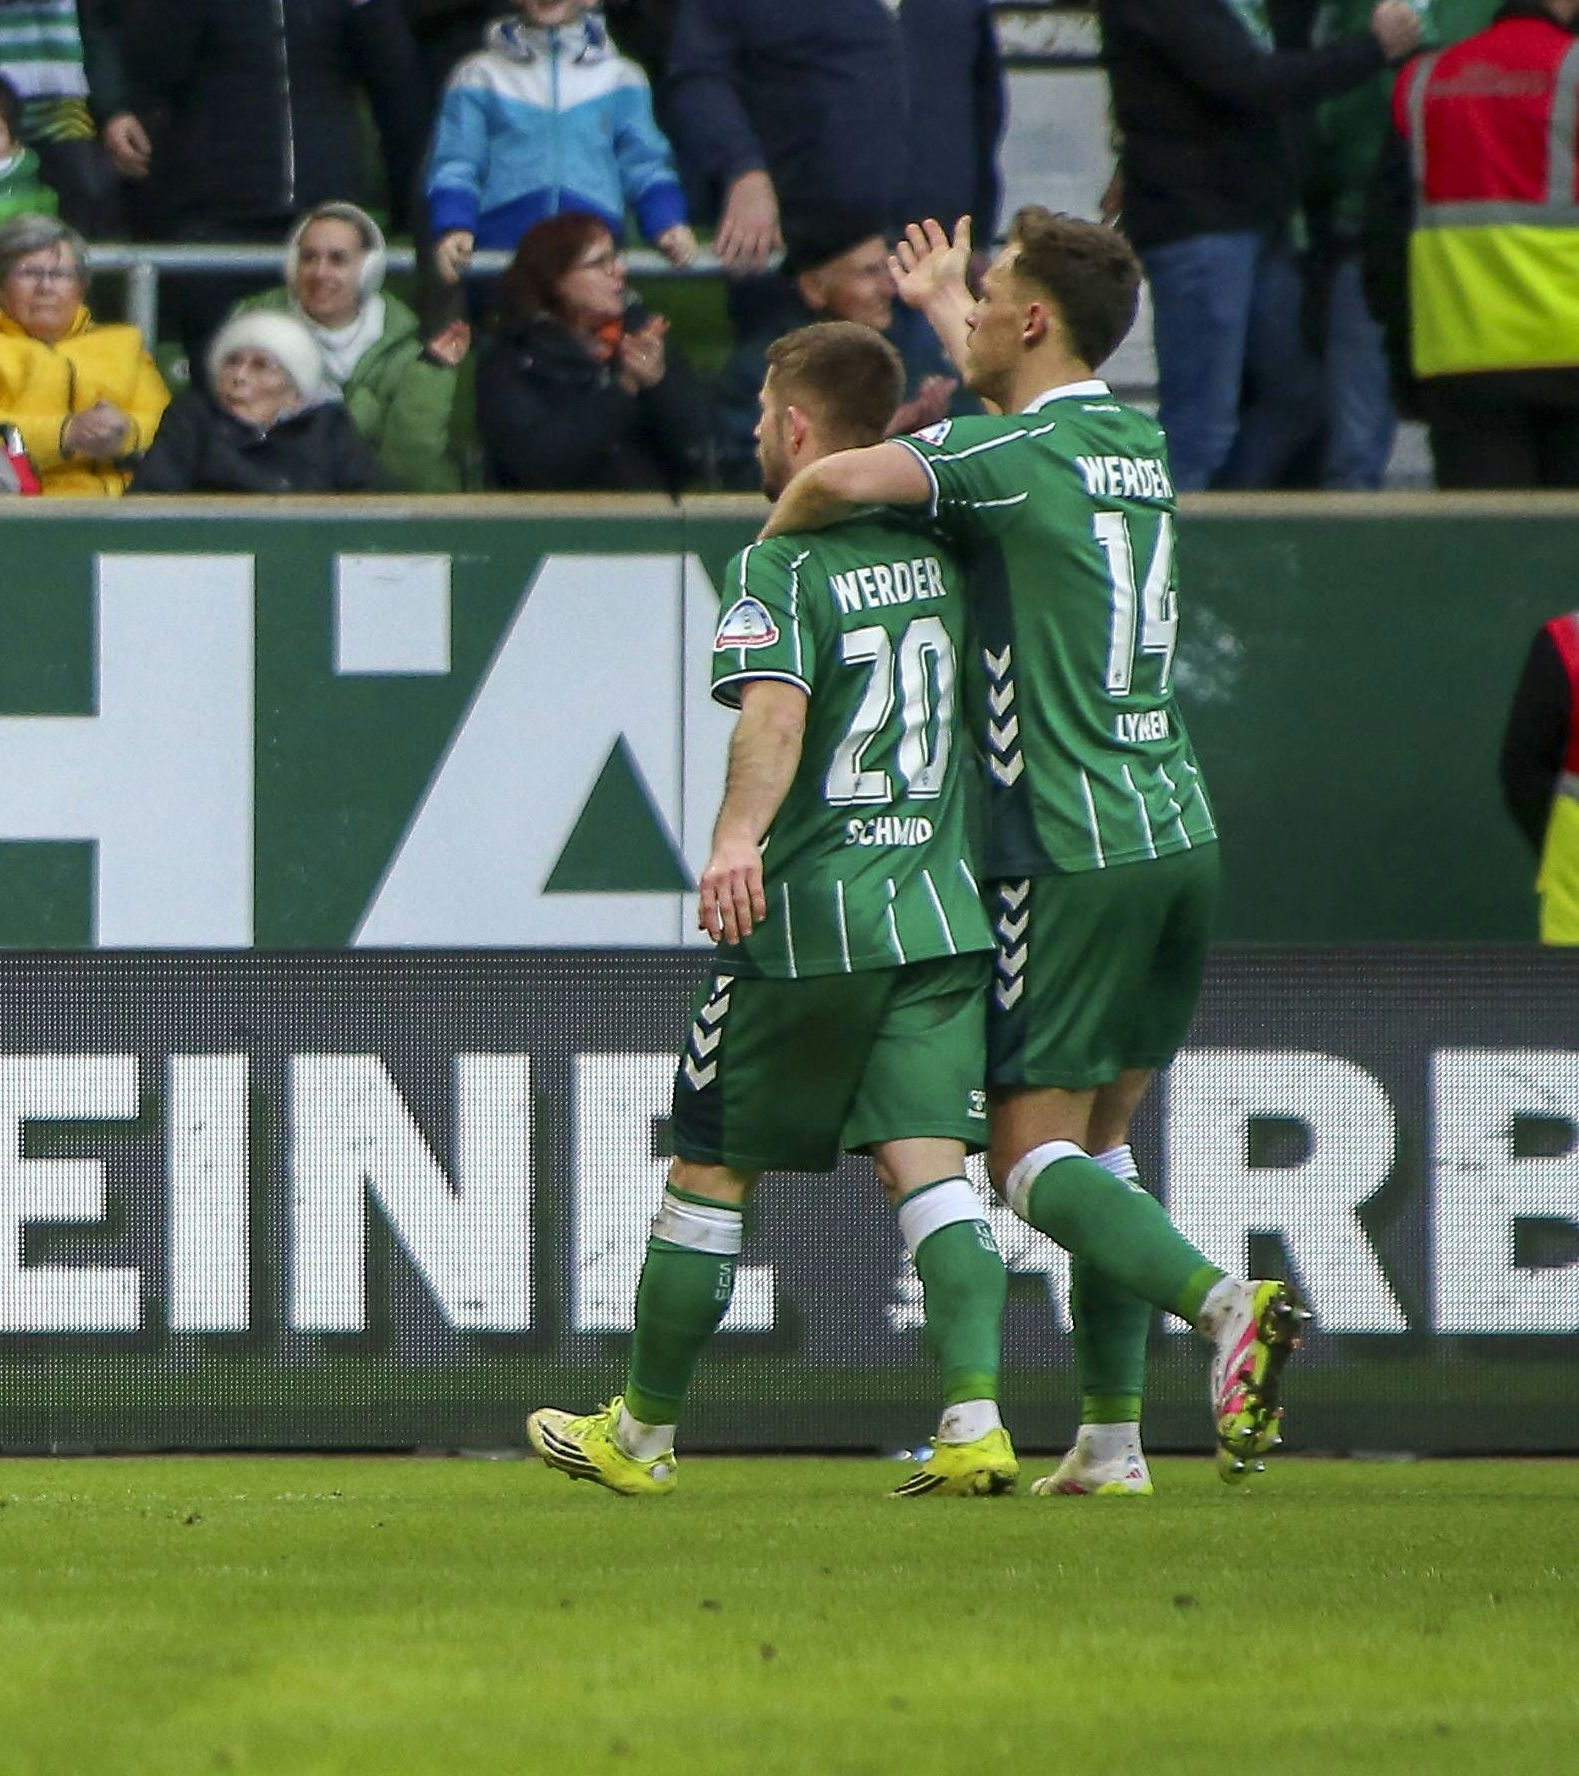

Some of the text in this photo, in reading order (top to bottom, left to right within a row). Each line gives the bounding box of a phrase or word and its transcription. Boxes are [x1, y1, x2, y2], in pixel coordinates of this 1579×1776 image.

[1076, 455, 1174, 498] WERDER
[829, 557, 946, 615] WERDER
[1093, 511, 1179, 696] 14
[826, 616, 957, 807] 20
[845, 817, 934, 847] SCHMID
